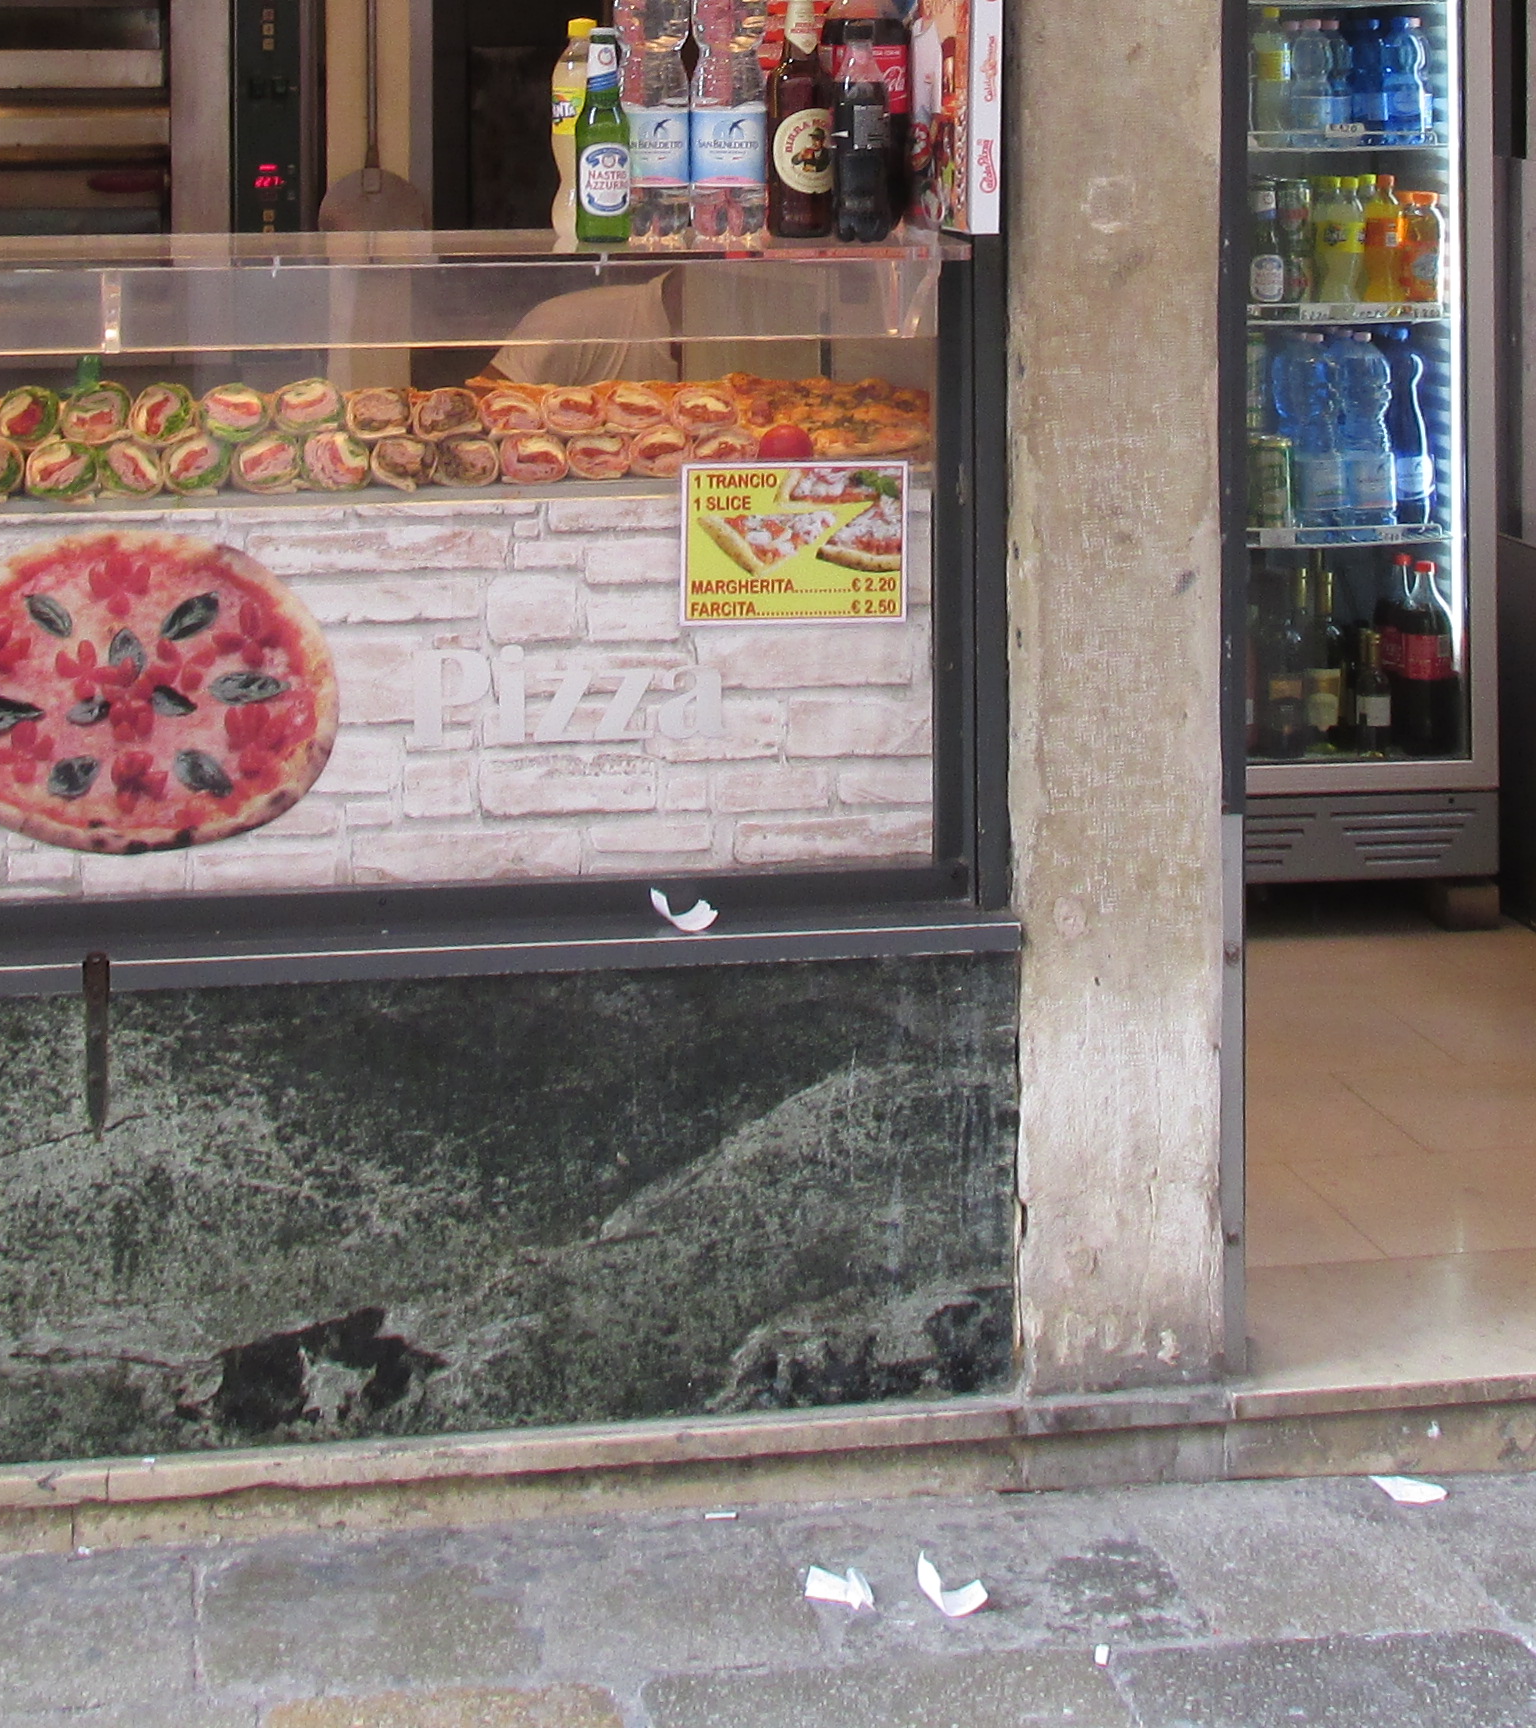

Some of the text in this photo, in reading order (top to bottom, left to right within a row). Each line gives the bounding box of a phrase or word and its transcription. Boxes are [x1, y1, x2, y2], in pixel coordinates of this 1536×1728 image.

[588, 170, 627, 180] NASTRO
[585, 179, 629, 191] AZZURRO
[694, 473, 777, 489] 1 TRANCIO
[694, 496, 751, 511] 1 SLICE
[851, 578, 861, 592] €
[865, 577, 896, 592] 2.20
[851, 600, 860, 614] €
[865, 599, 896, 614] 2.50
[407, 644, 733, 748] Pizza
